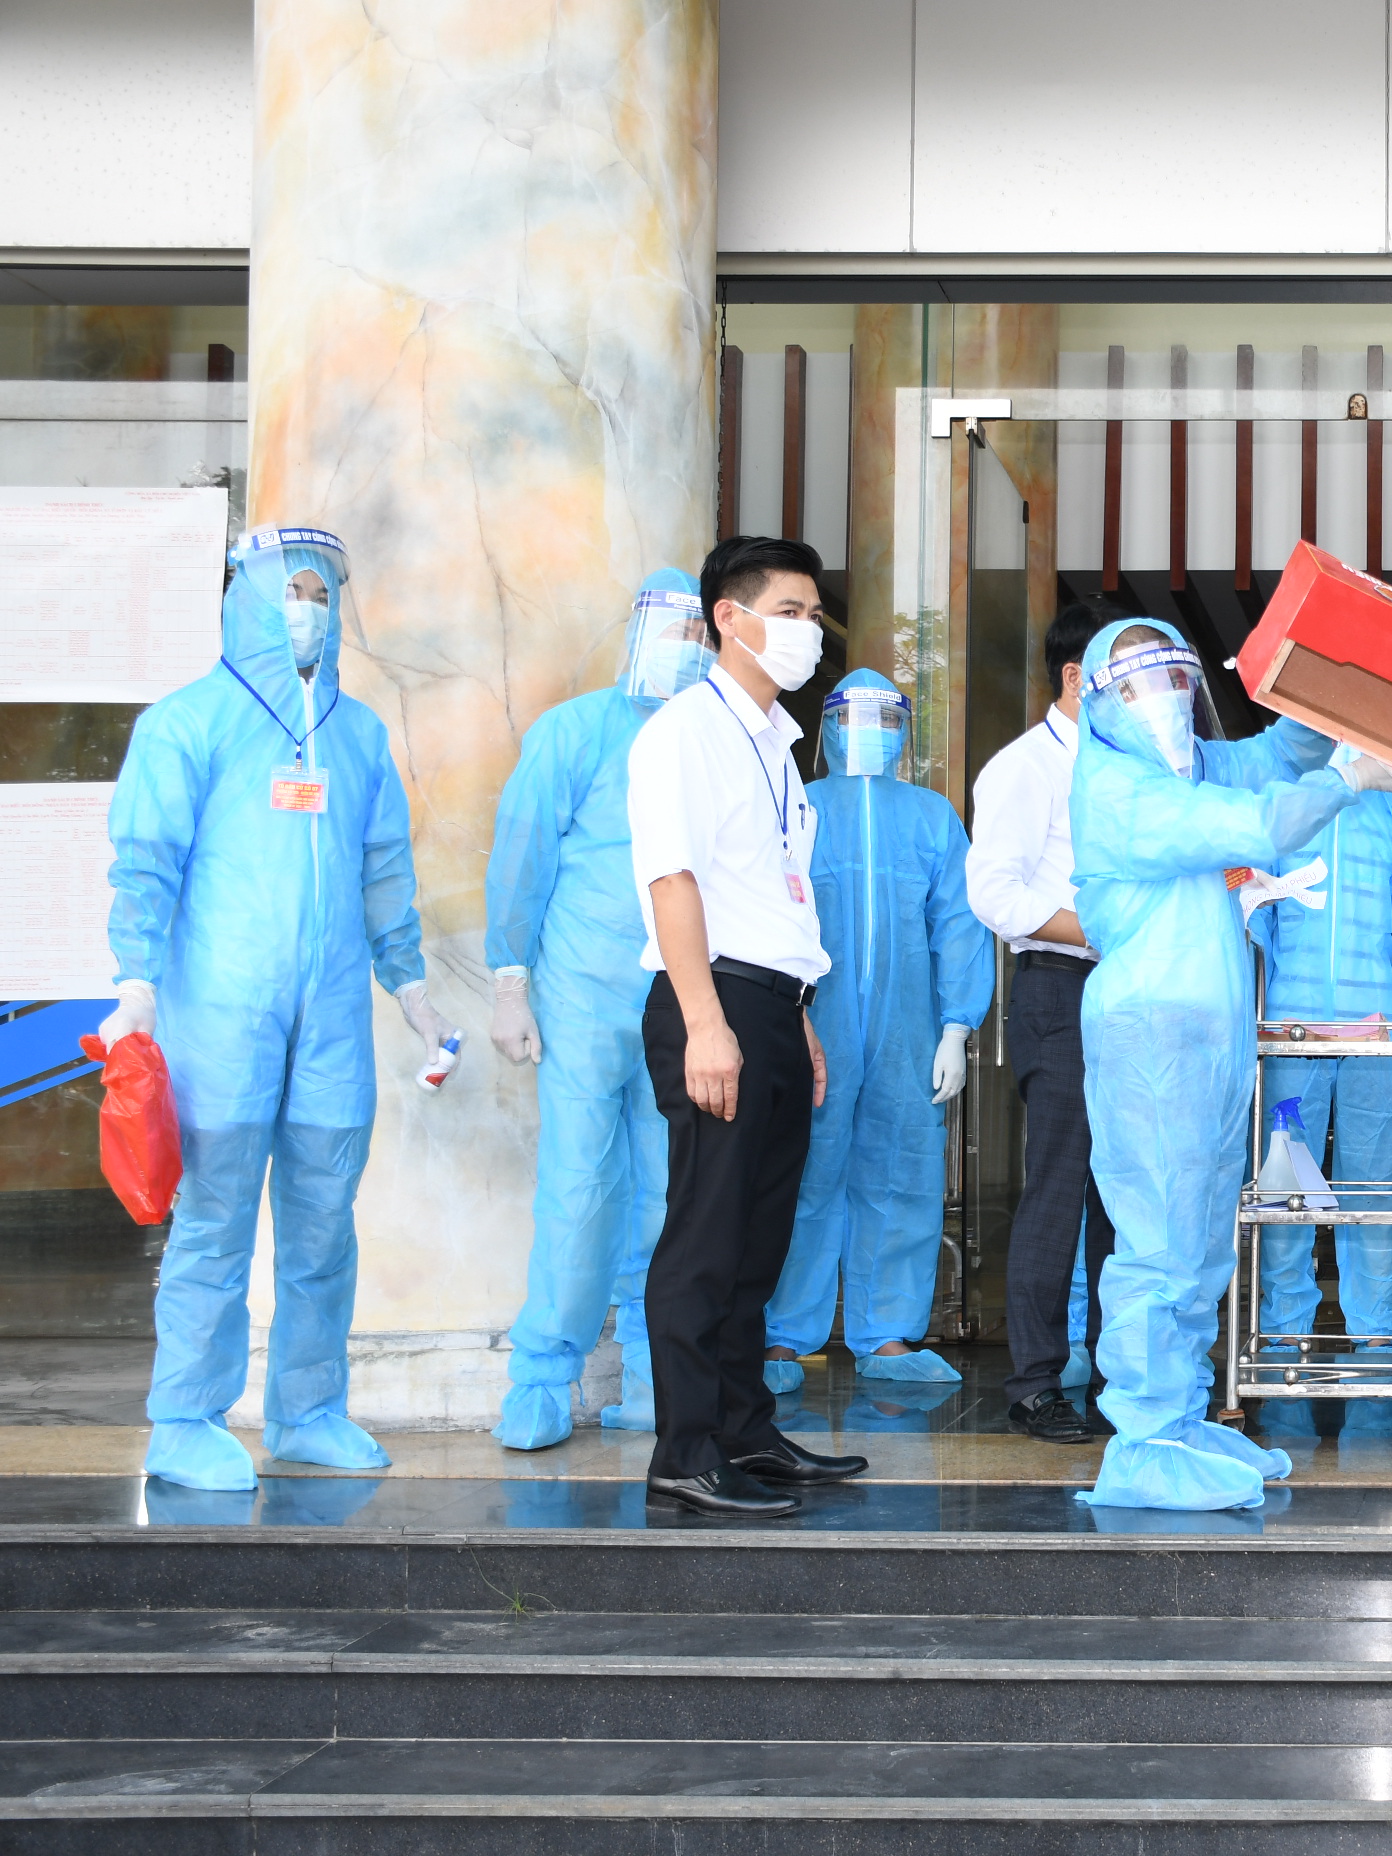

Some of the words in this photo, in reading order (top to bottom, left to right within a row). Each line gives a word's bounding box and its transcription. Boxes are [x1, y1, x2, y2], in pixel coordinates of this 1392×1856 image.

[668, 595, 696, 604] Face
[845, 690, 869, 699] Face
[872, 690, 901, 701] Shield
